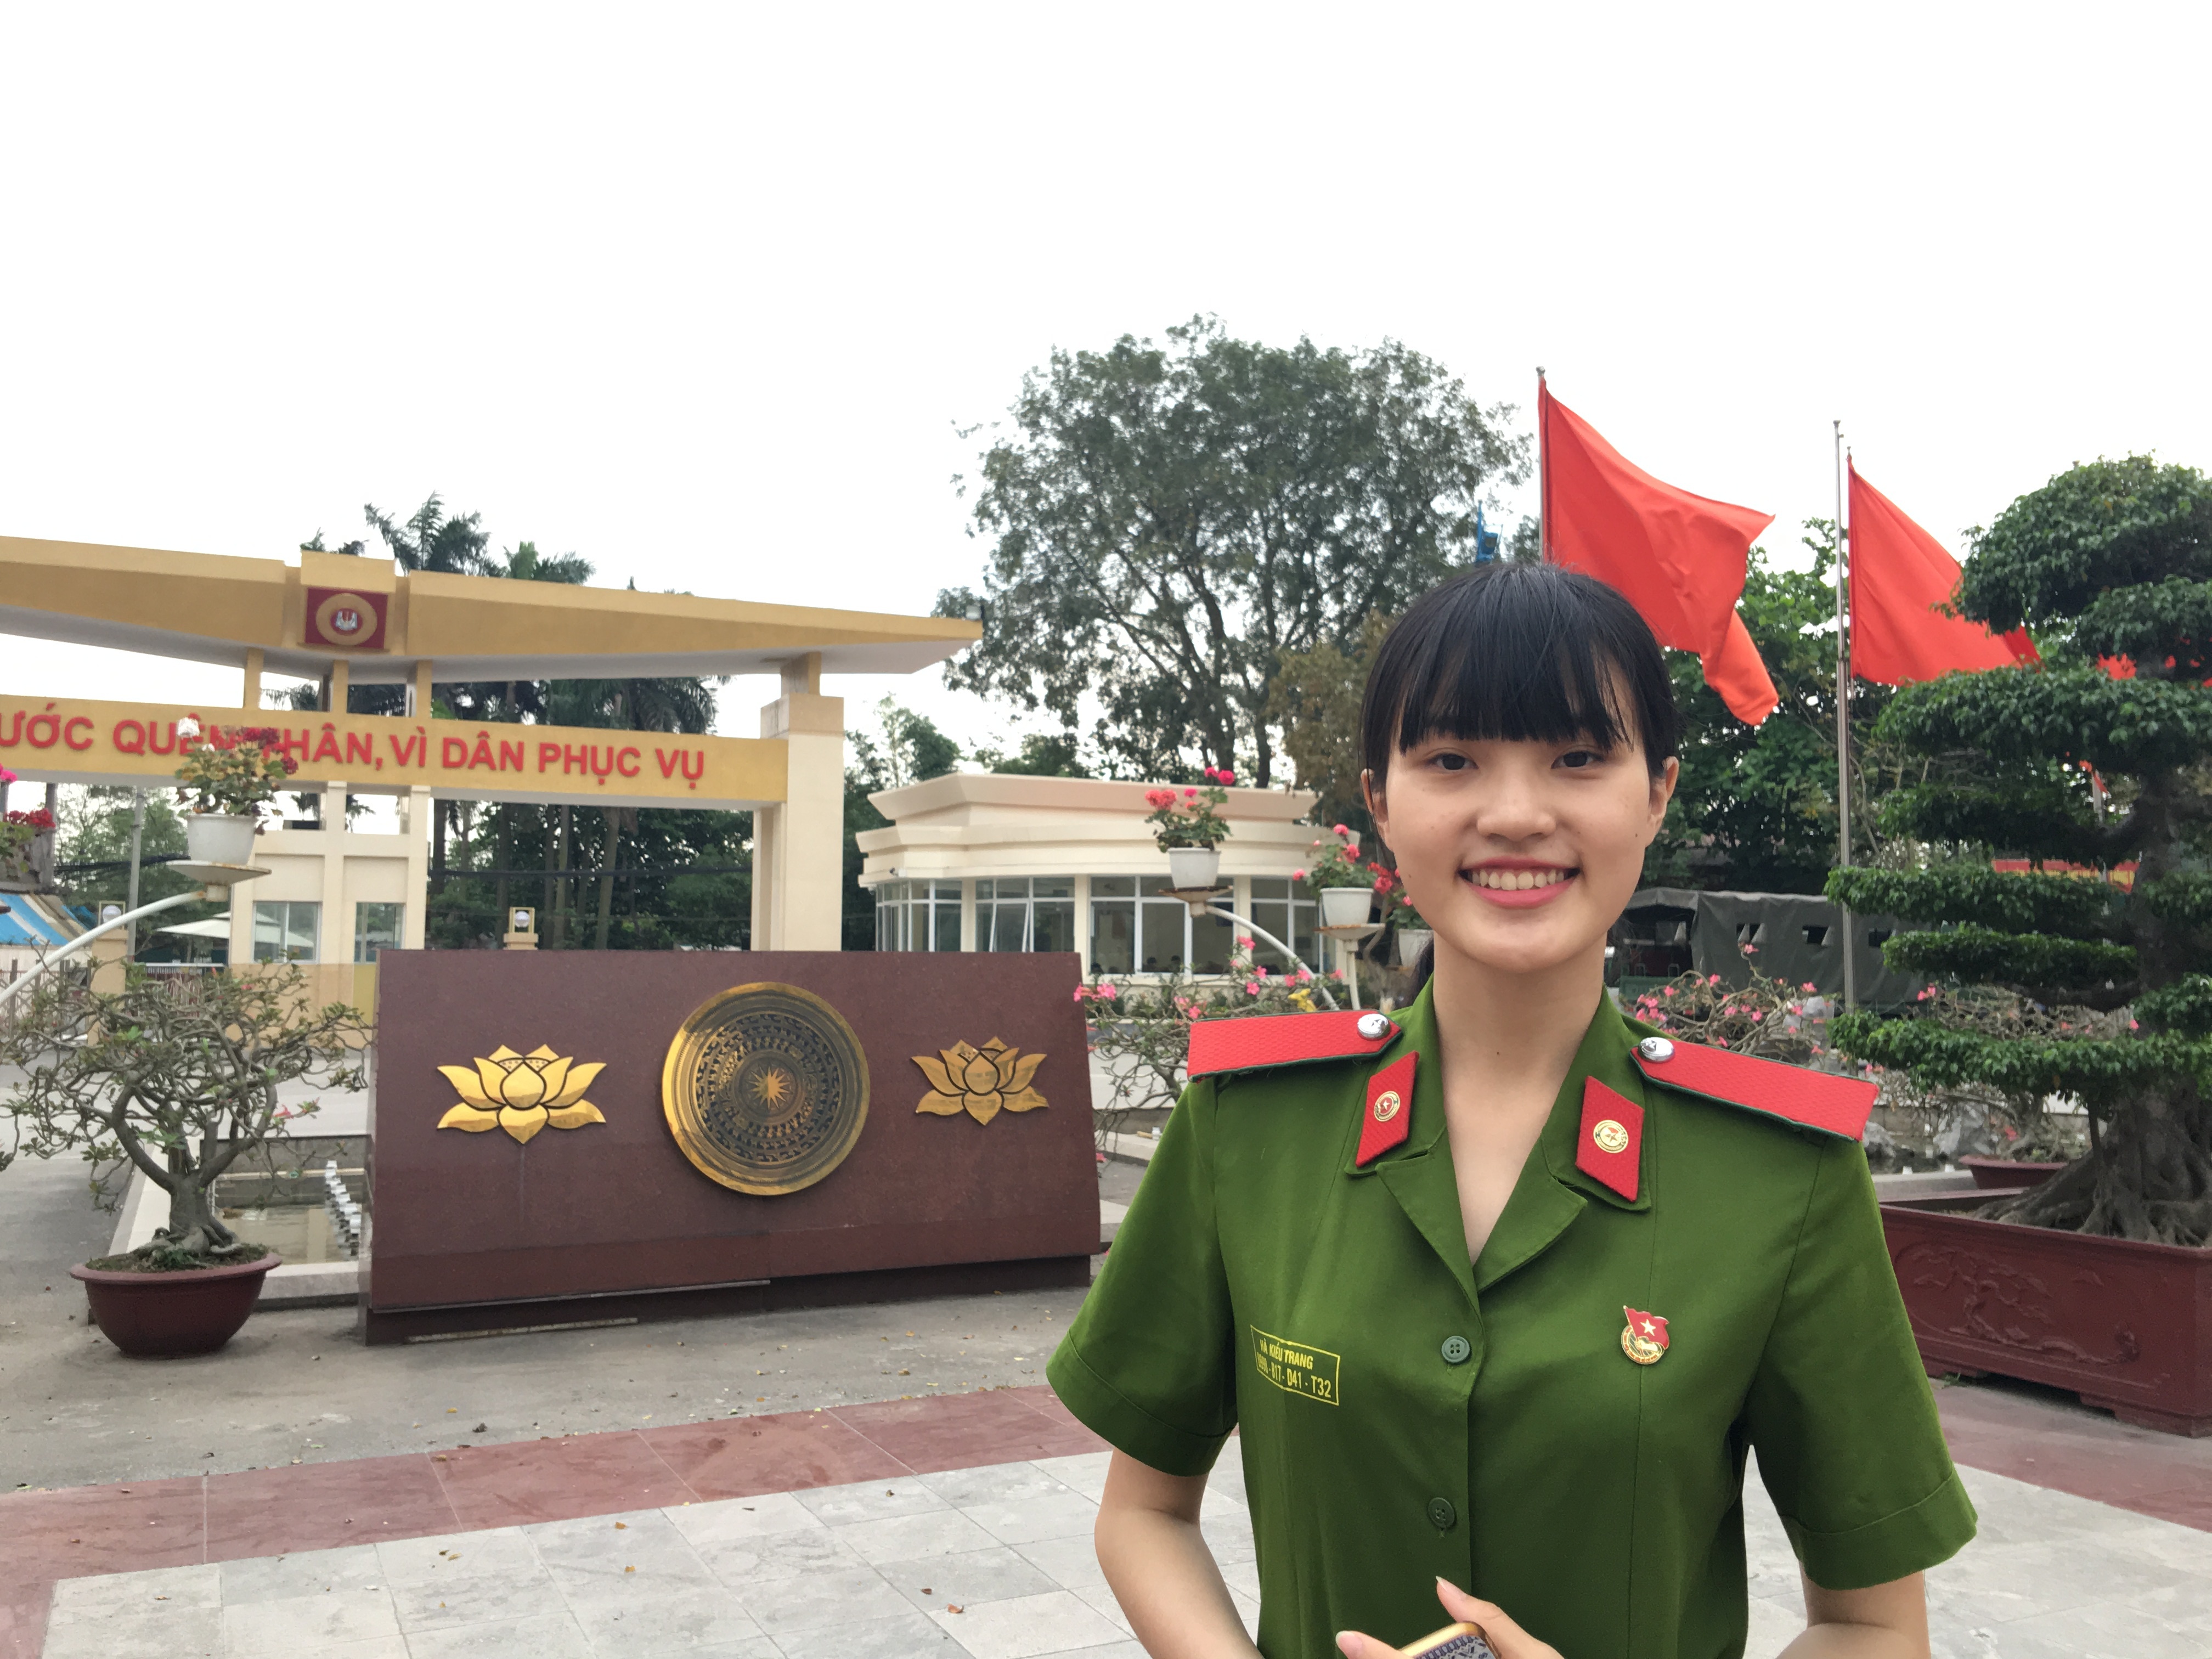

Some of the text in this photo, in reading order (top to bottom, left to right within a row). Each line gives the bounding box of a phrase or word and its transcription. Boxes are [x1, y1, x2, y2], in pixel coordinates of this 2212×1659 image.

[254, 723, 382, 771] HÂN,
[389, 726, 427, 767] VÌ
[442, 730, 524, 771] DÂN
[538, 742, 641, 785] PHỤC
[656, 748, 705, 788] VỤ
[1284, 1349, 1314, 1370] TRANG
[1286, 1368, 1302, 1389] D41
[1311, 1375, 1331, 1398] T32
